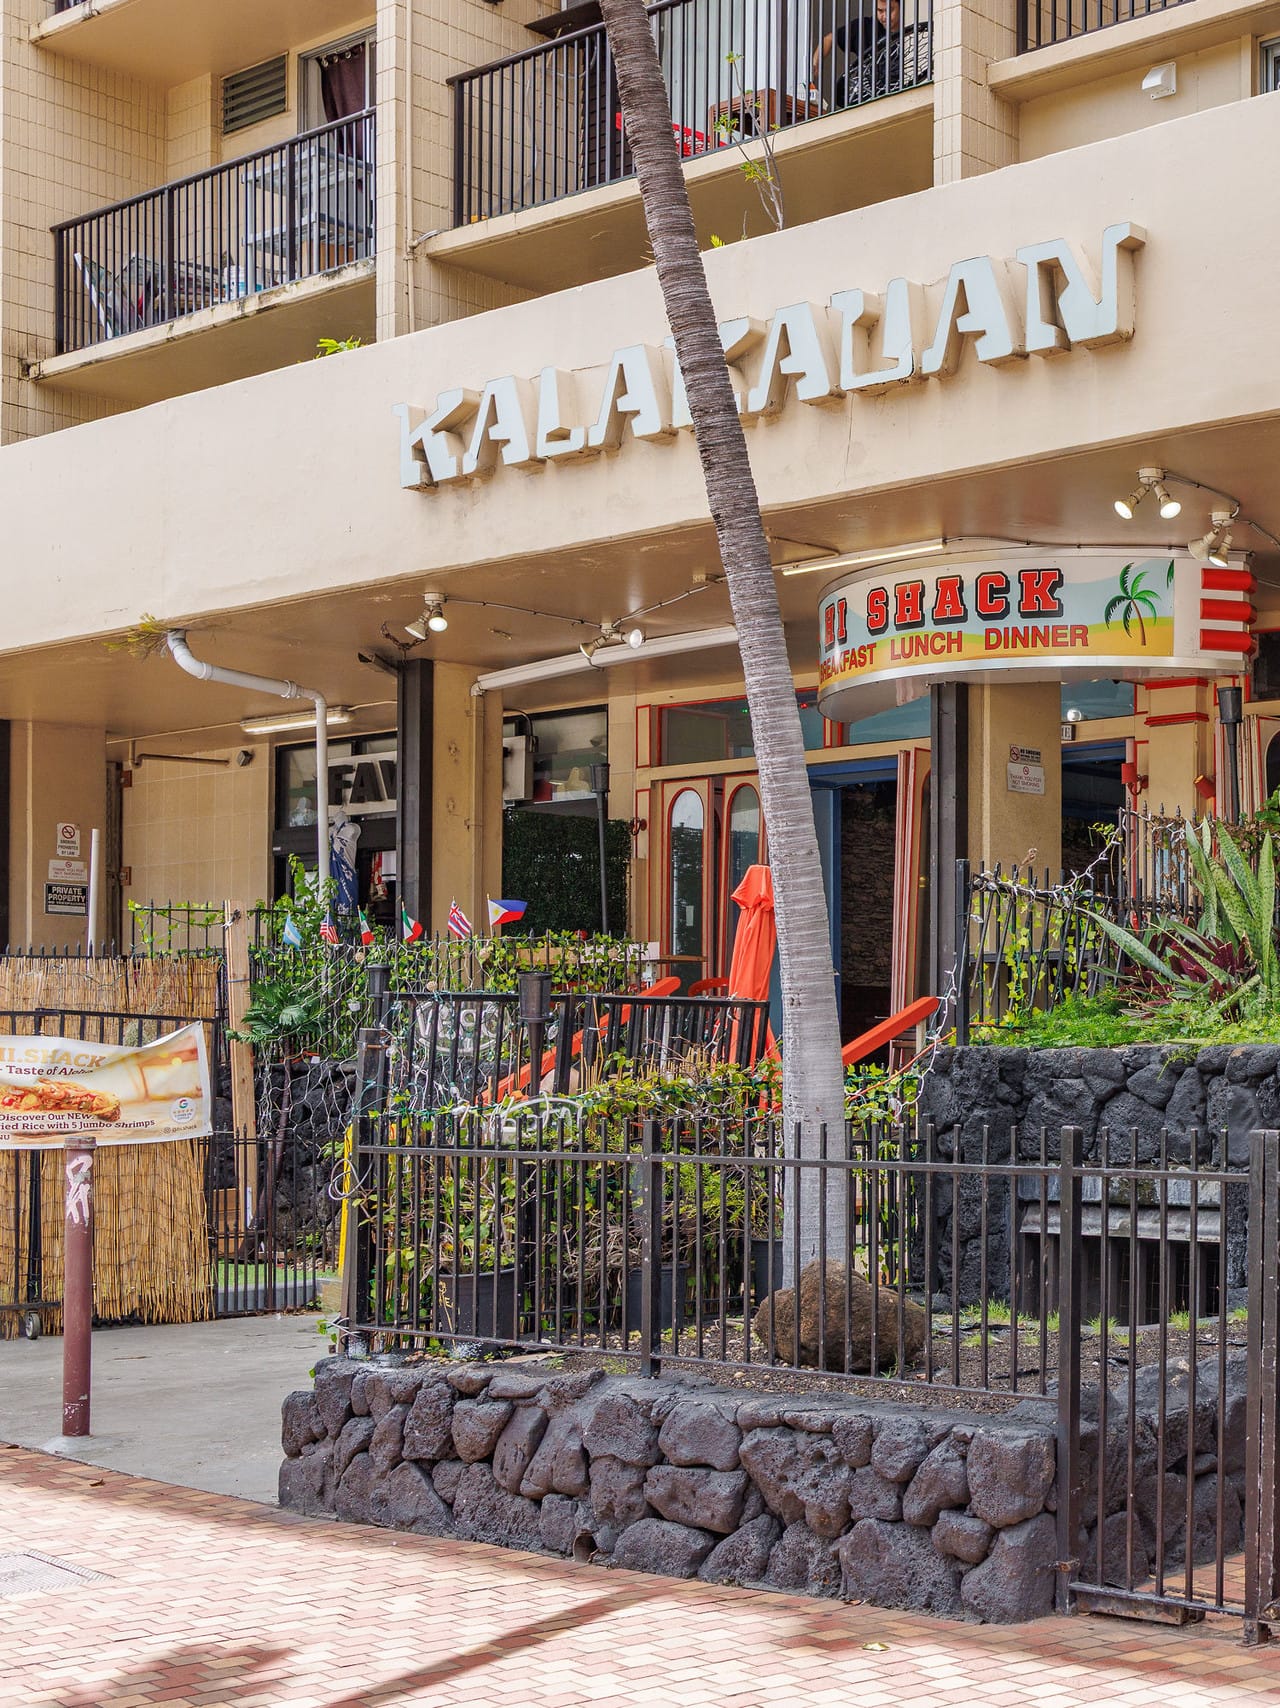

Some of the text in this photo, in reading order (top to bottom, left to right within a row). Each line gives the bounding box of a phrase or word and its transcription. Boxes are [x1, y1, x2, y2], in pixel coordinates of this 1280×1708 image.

[824, 567, 1064, 653] HI SHACK
[890, 630, 963, 661] LUNCH
[984, 624, 1090, 652] DINNER
[52, 886, 82, 895] PRIVATE
[48, 893, 85, 902] PROPERTY
[6, 1065, 44, 1076] Taste
[46, 1066, 58, 1076] of
[0, 1113, 46, 1121] Discover
[48, 1113, 65, 1121] Our
[0, 1122, 19, 1130] ied
[22, 1122, 45, 1130] Rice
[47, 1121, 70, 1130] with
[72, 1121, 78, 1129] 5
[79, 1121, 112, 1130] Jumbo
